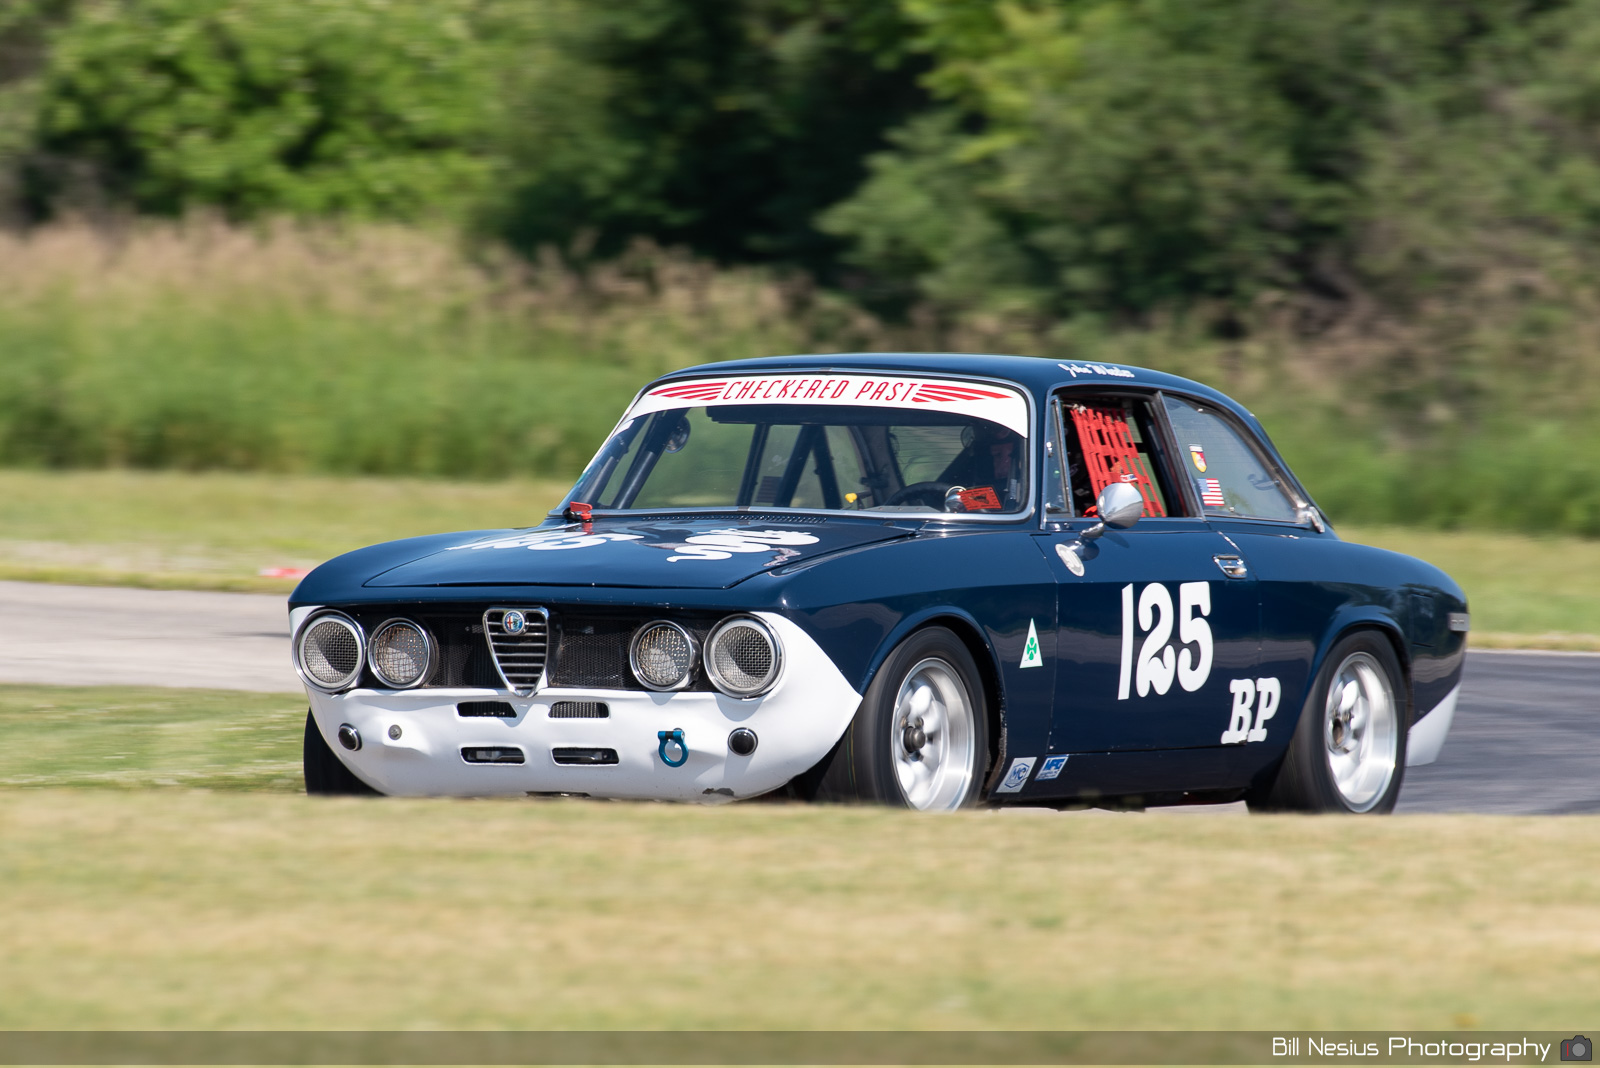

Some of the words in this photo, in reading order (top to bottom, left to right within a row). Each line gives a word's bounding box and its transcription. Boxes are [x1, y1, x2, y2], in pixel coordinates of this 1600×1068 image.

[722, 379, 850, 400] CHECKERED
[854, 380, 918, 402] PAST
[1117, 581, 1214, 700] 125
[1221, 677, 1281, 744] BP
